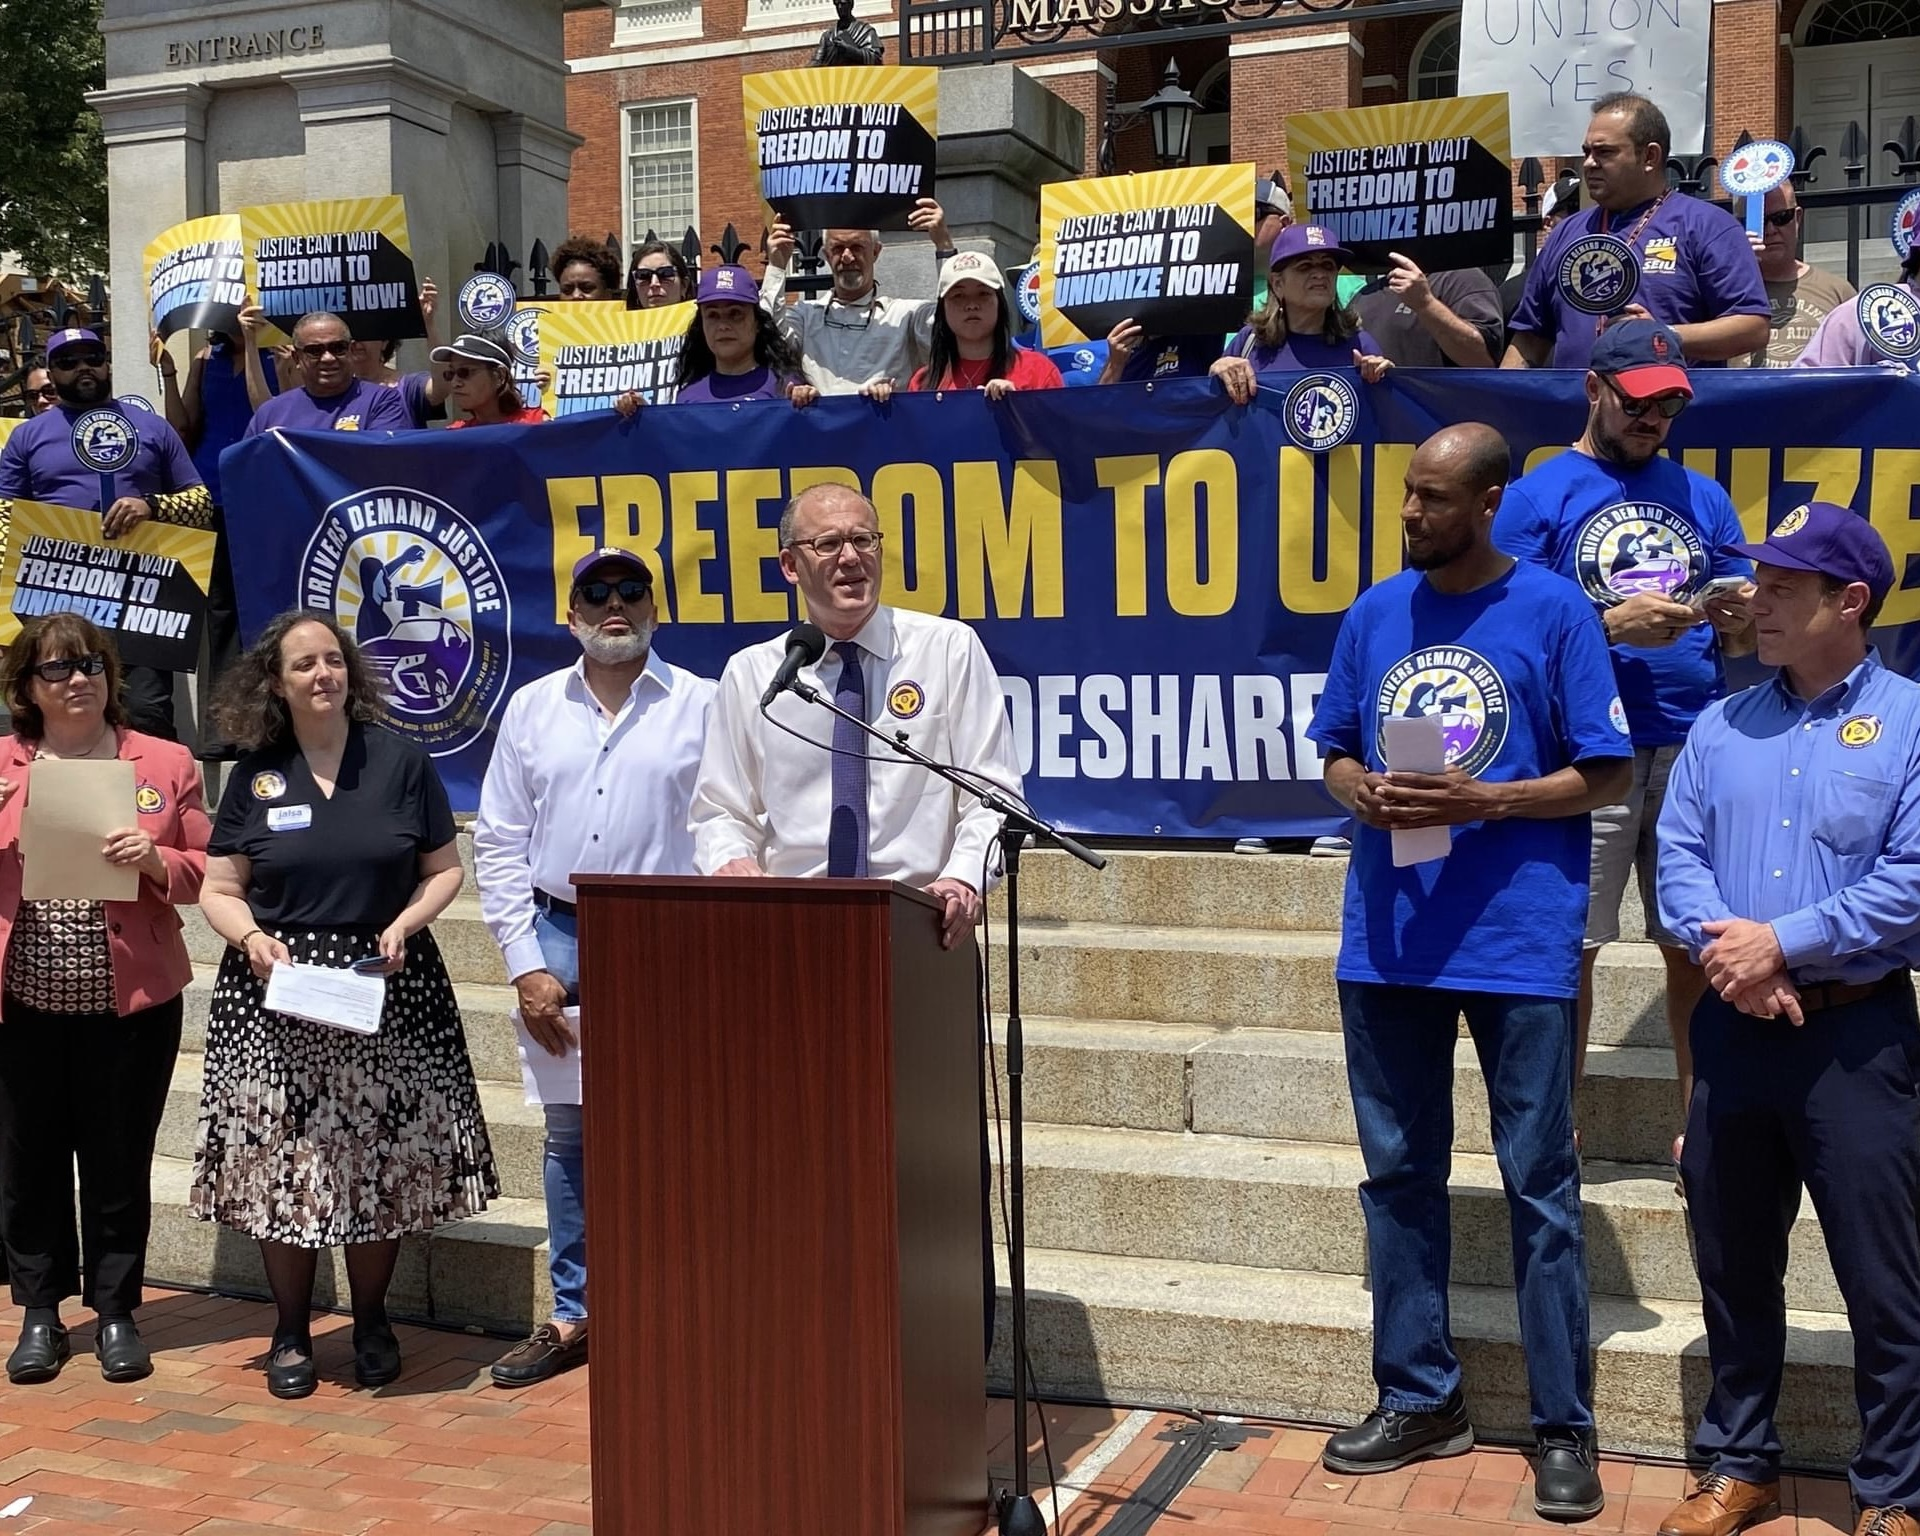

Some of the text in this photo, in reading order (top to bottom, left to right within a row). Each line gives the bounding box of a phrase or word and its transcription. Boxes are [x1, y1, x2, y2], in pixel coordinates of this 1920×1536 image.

[1485, 0, 1680, 45] UNION
[165, 24, 325, 66] ENTRANCE
[1530, 48, 1653, 107] YES!
[755, 103, 901, 132] JUSTICE CAN'T WAIT
[758, 129, 886, 166] FREEDOM TO
[1303, 136, 1471, 176] JUSTICE CAN'T WAIT
[762, 163, 922, 199] UNIONIZE NOW!
[1307, 166, 1456, 210] FREEDOM TO
[1055, 202, 1217, 241] JUSTICE CAN'T WAIT
[1424, 198, 1498, 236] NOW!
[222, 240, 244, 256] WA
[254, 230, 379, 259] JUSTICE CAN'T WAIT
[1054, 231, 1201, 275] FREEDOM TO
[217, 258, 244, 280] TO
[257, 255, 371, 288] FREEDOM TO
[1643, 260, 1676, 270] SEIU
[213, 281, 246, 306] NO
[259, 282, 407, 317] UNIONIZE NOW!
[1053, 267, 1164, 308] UNIONIZE
[1167, 263, 1239, 297] NOW!
[554, 344, 614, 365] JUSTICE
[617, 339, 658, 362] CAN'T
[555, 362, 654, 395] FREEDOM
[1095, 448, 1240, 617] TO
[1581, 506, 1702, 562] DRIVERS DEMAND JUSTICE
[20, 534, 178, 578] JUSTICE CAN'T WAIT
[307, 497, 501, 614] DRIVERS DEMAND JUSTICE
[15, 557, 161, 604] FREEDOM TO
[121, 605, 192, 640] NOW!
[1378, 651, 1504, 715] DRIVERS DEMAND JUSTICE
